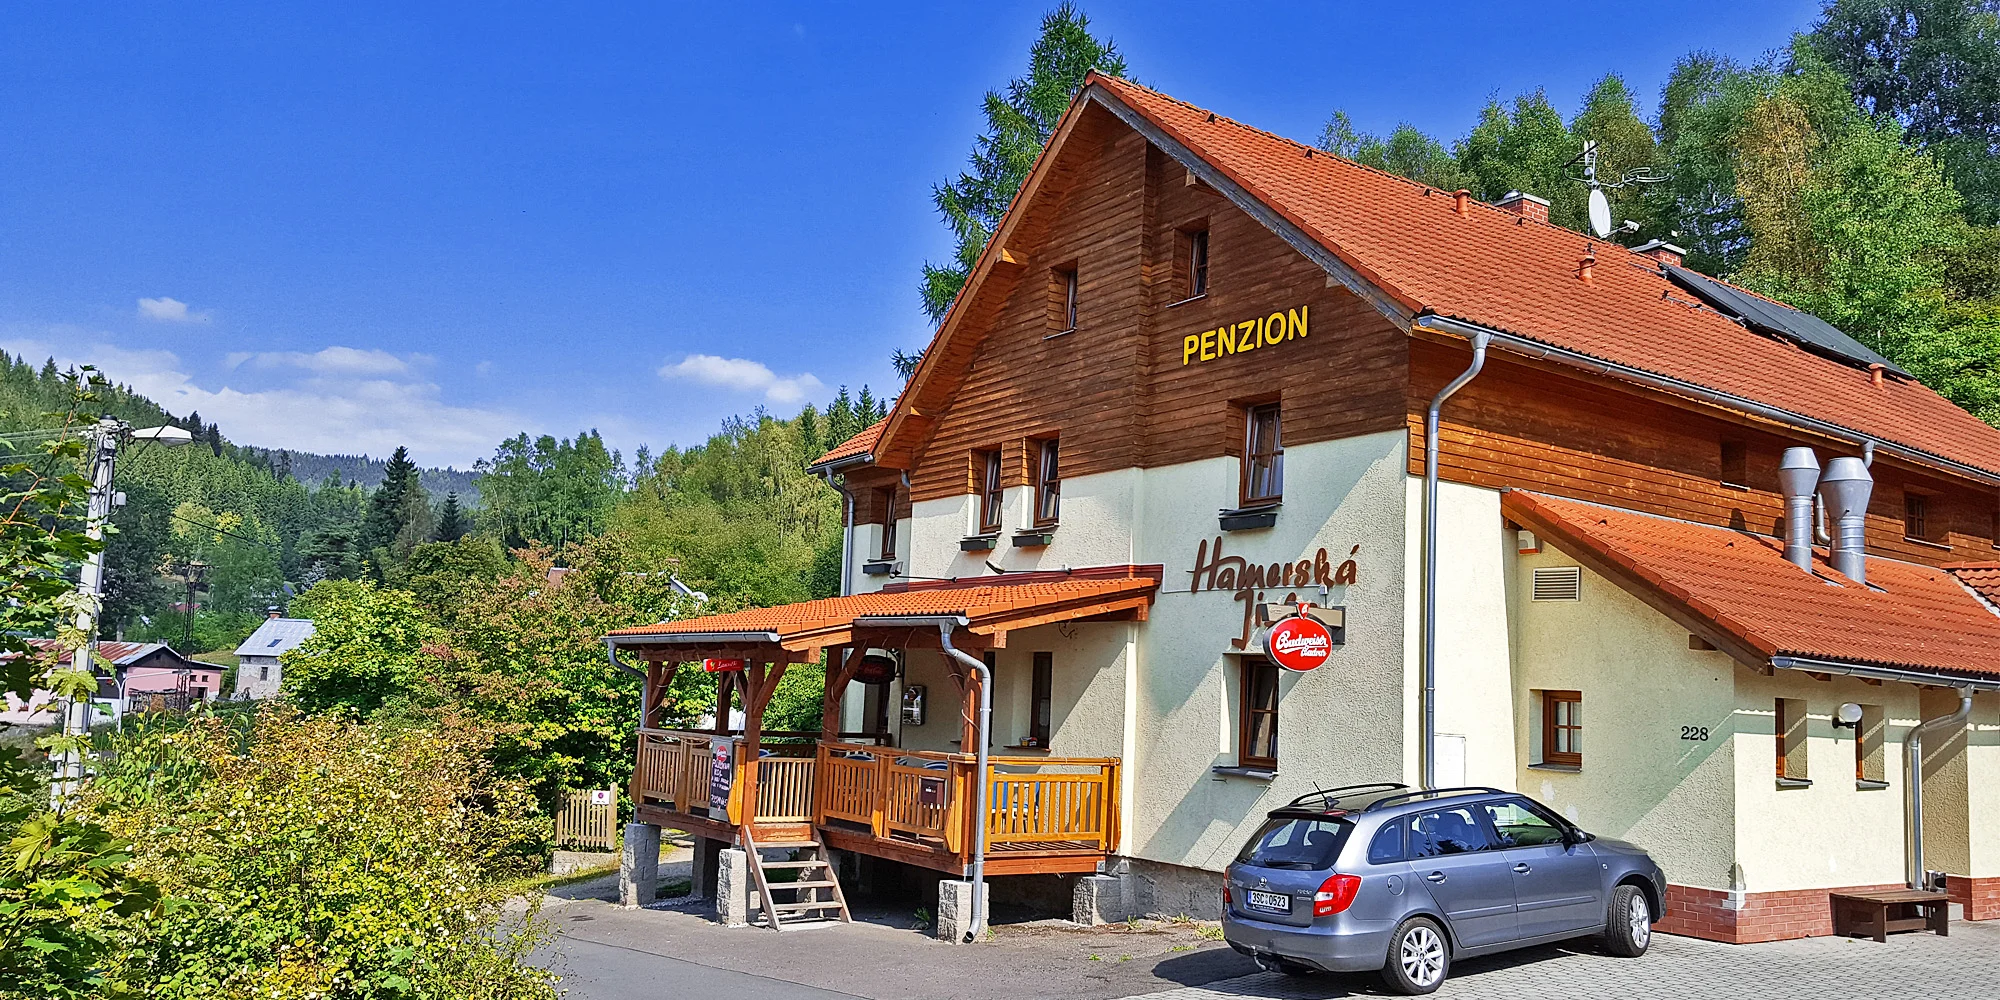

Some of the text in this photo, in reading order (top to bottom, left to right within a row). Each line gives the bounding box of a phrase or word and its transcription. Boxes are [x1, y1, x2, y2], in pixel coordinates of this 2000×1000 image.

[1183, 305, 1308, 366] PENZION
[1186, 536, 1360, 594] Hamerská
[1276, 630, 1328, 652] Budweiser
[1681, 725, 1709, 741] 228
[1252, 892, 1286, 908] 3SC 0523
